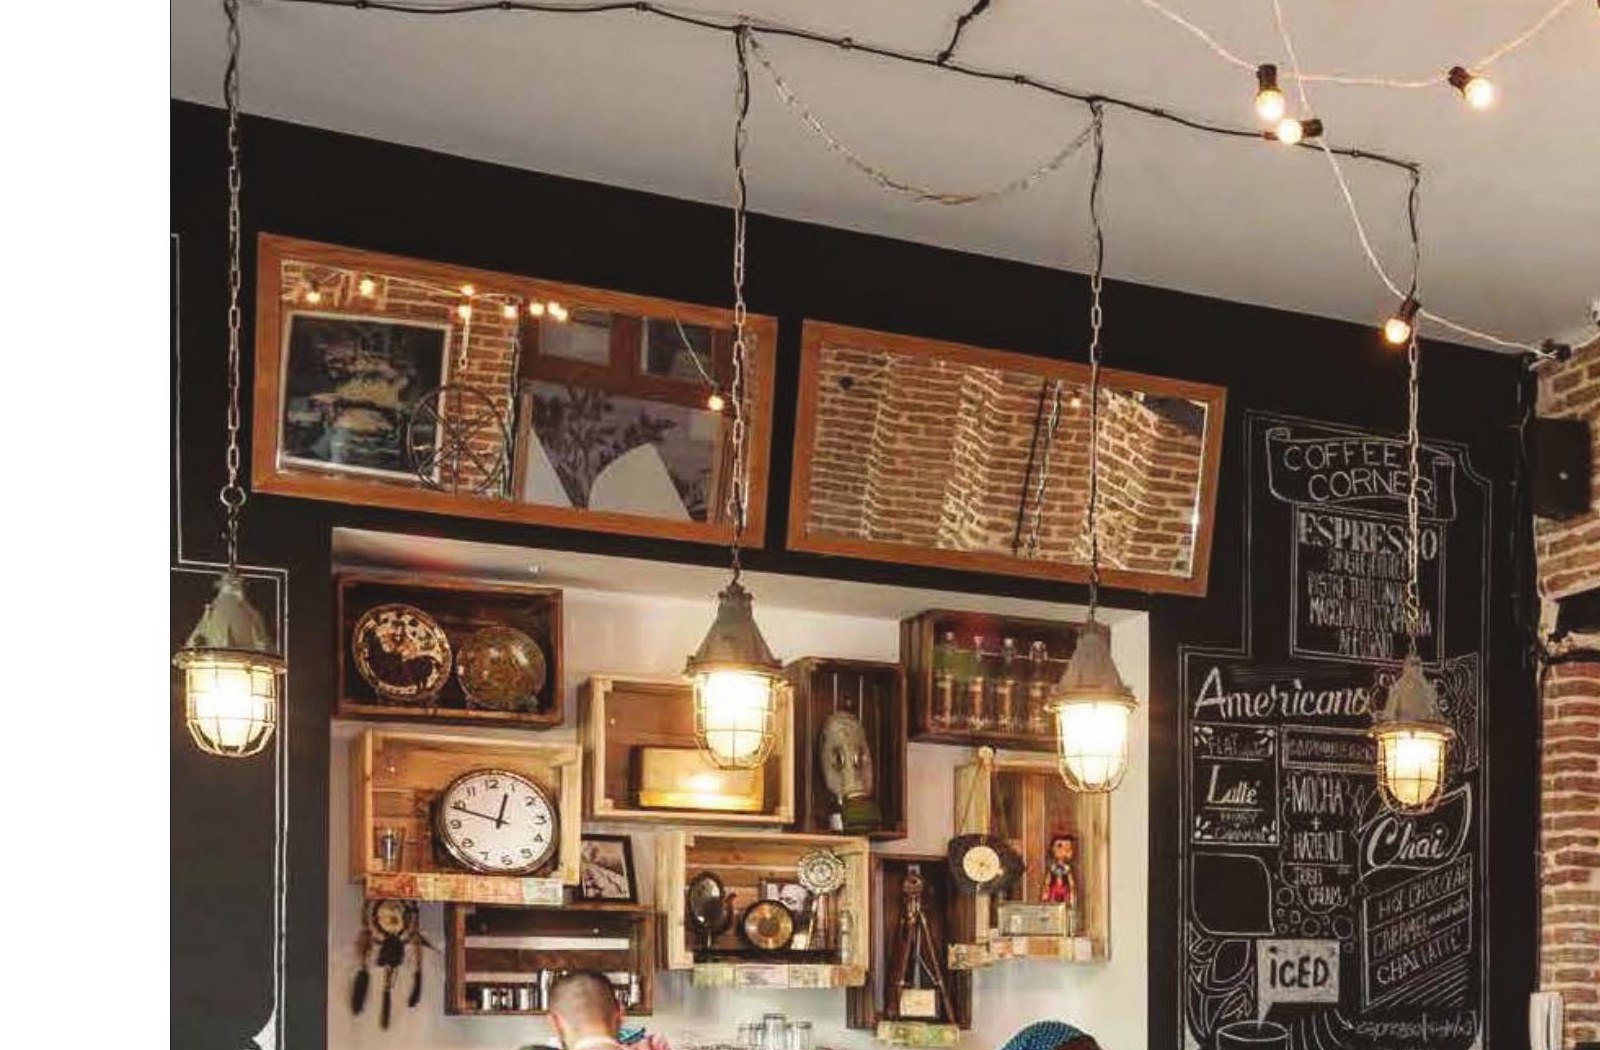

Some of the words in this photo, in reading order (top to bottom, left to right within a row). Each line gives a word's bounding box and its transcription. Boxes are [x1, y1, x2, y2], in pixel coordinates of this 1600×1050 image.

[1283, 442, 1403, 472] COFFEE
[1308, 467, 1435, 504] CORNER
[1194, 666, 1371, 719] Americano
[1366, 816, 1446, 869] Chai
